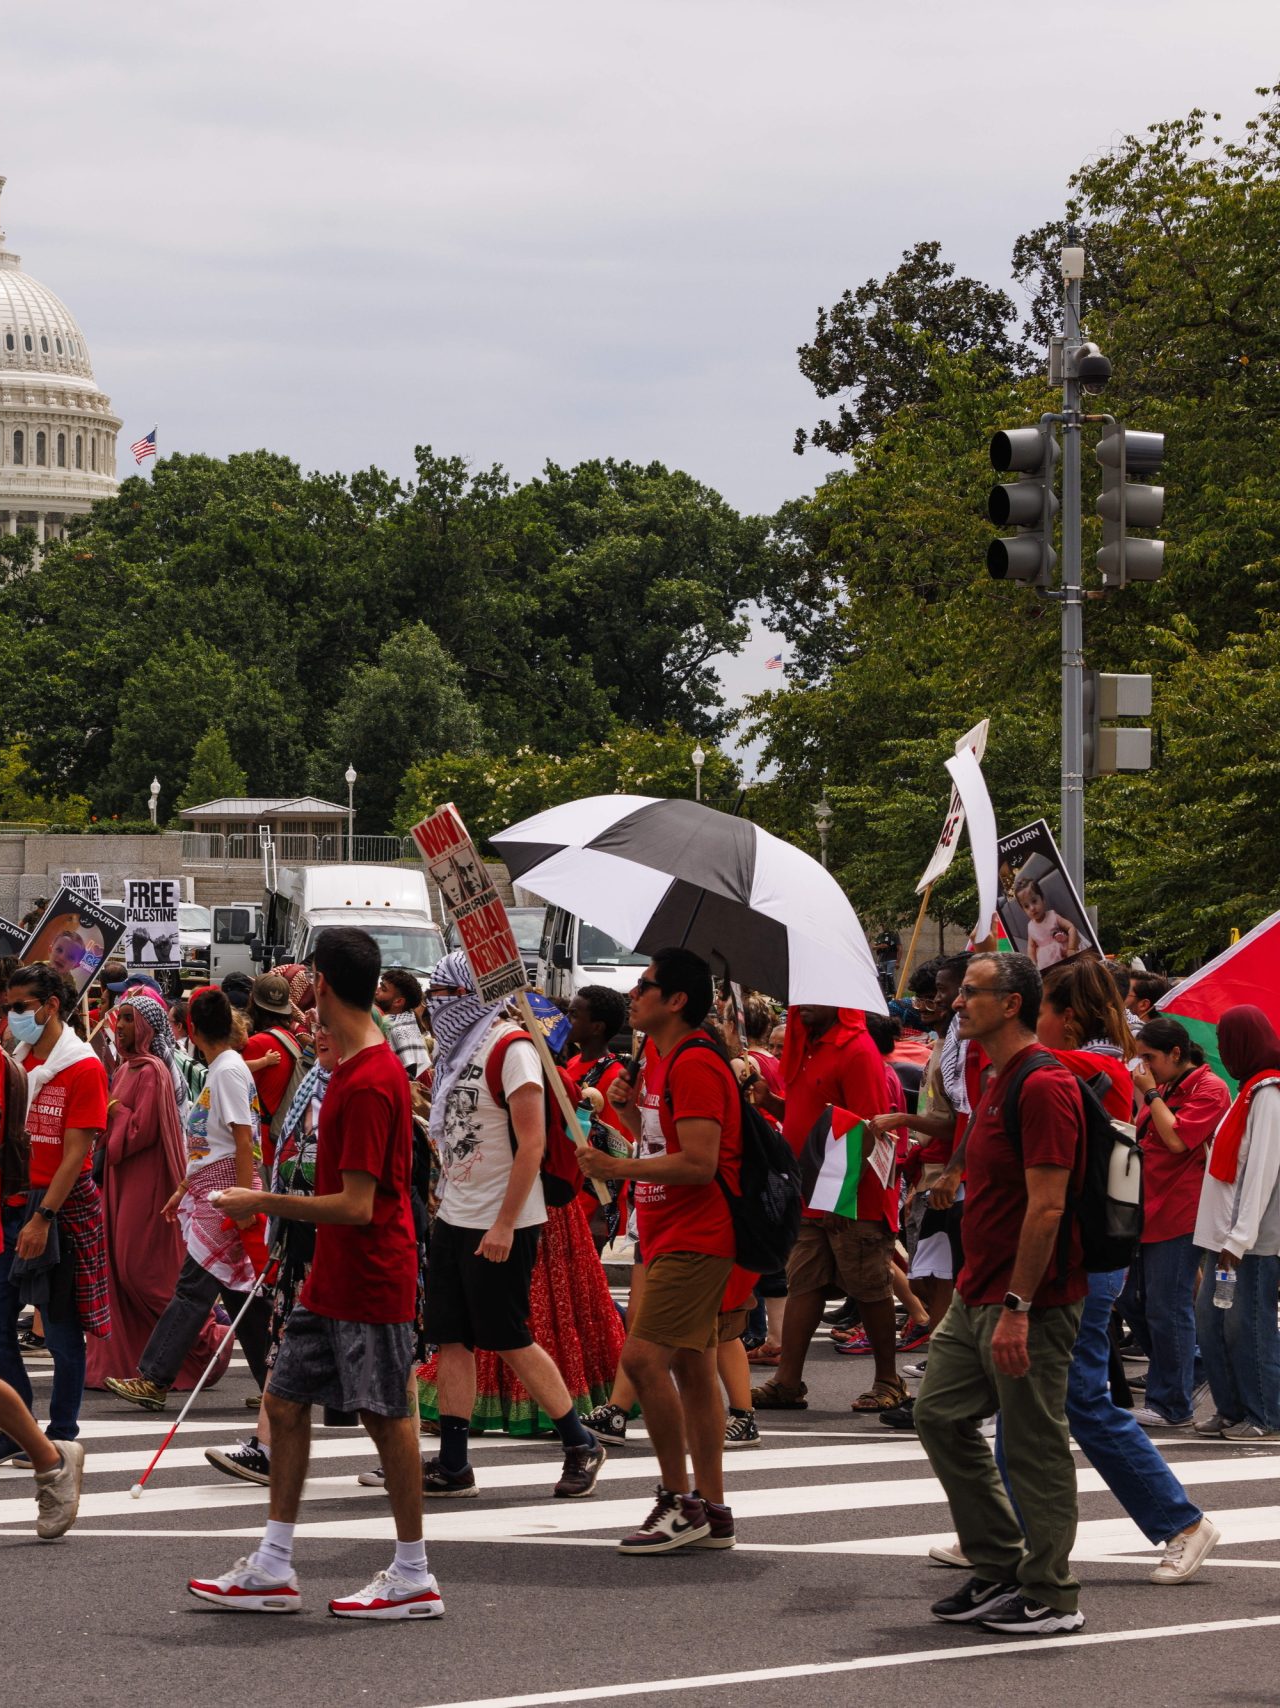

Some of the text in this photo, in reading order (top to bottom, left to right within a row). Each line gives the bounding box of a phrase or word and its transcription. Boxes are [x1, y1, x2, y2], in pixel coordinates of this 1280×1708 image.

[1000, 828, 1040, 853] MOURN
[62, 875, 98, 888] STAND WITH
[129, 882, 174, 908] FREE
[68, 893, 82, 907] WE
[83, 904, 120, 931] MOURN
[126, 908, 177, 922] PALESTINE
[37, 1105, 63, 1117] ISRAEL
[648, 1185, 665, 1194] THE
